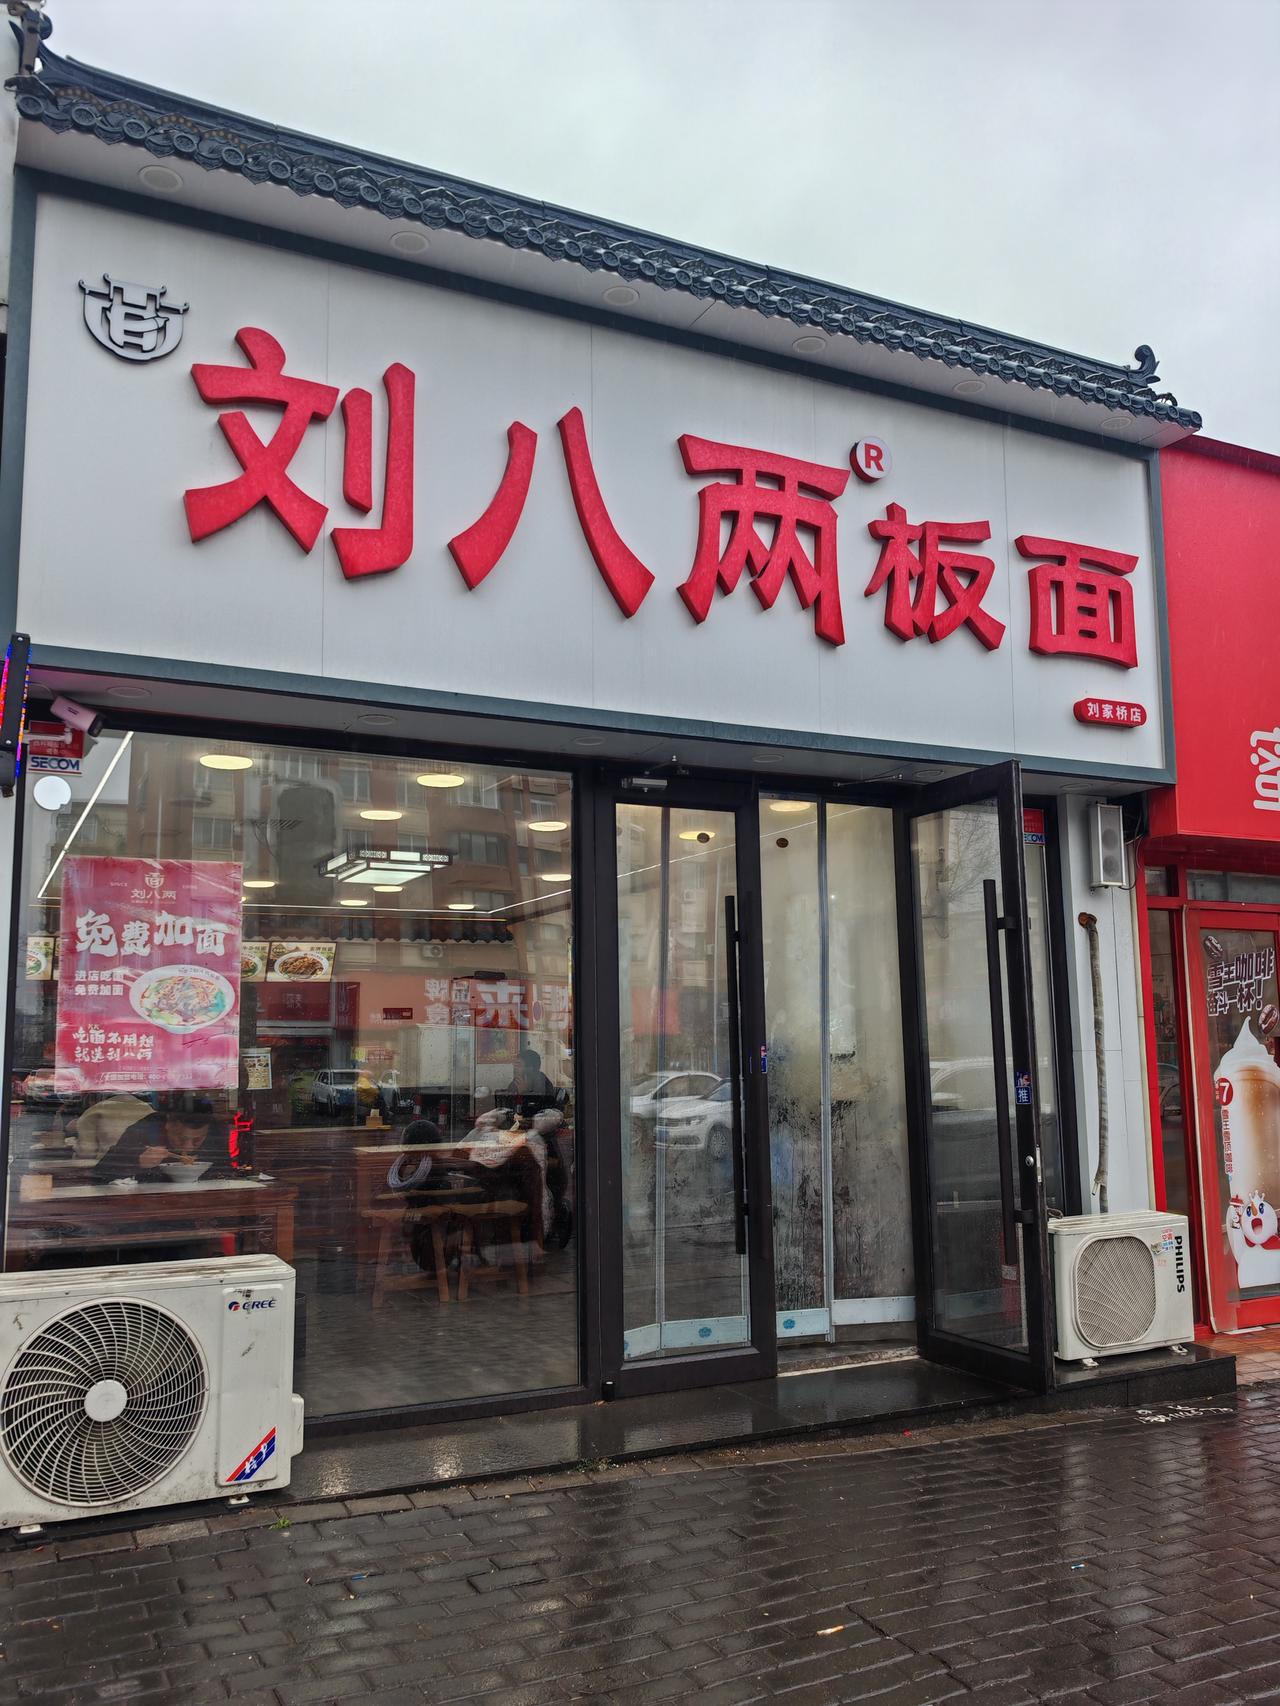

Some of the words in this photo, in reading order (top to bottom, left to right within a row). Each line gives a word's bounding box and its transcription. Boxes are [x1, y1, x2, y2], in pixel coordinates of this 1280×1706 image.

[183, 327, 1139, 670] 刘八两板面
[1087, 701, 1142, 723] 刘家桥店
[31, 756, 80, 771] SECOM
[130, 888, 177, 900] 刘八两
[75, 908, 230, 957] 免费加面
[1207, 947, 1275, 991] 雪王咖啡
[74, 984, 124, 996] 免费加面
[1018, 1087, 1029, 1103] 推
[1219, 1082, 1230, 1103] 7
[1174, 1235, 1185, 1293] PHILIPS
[242, 1298, 278, 1310] GREE
